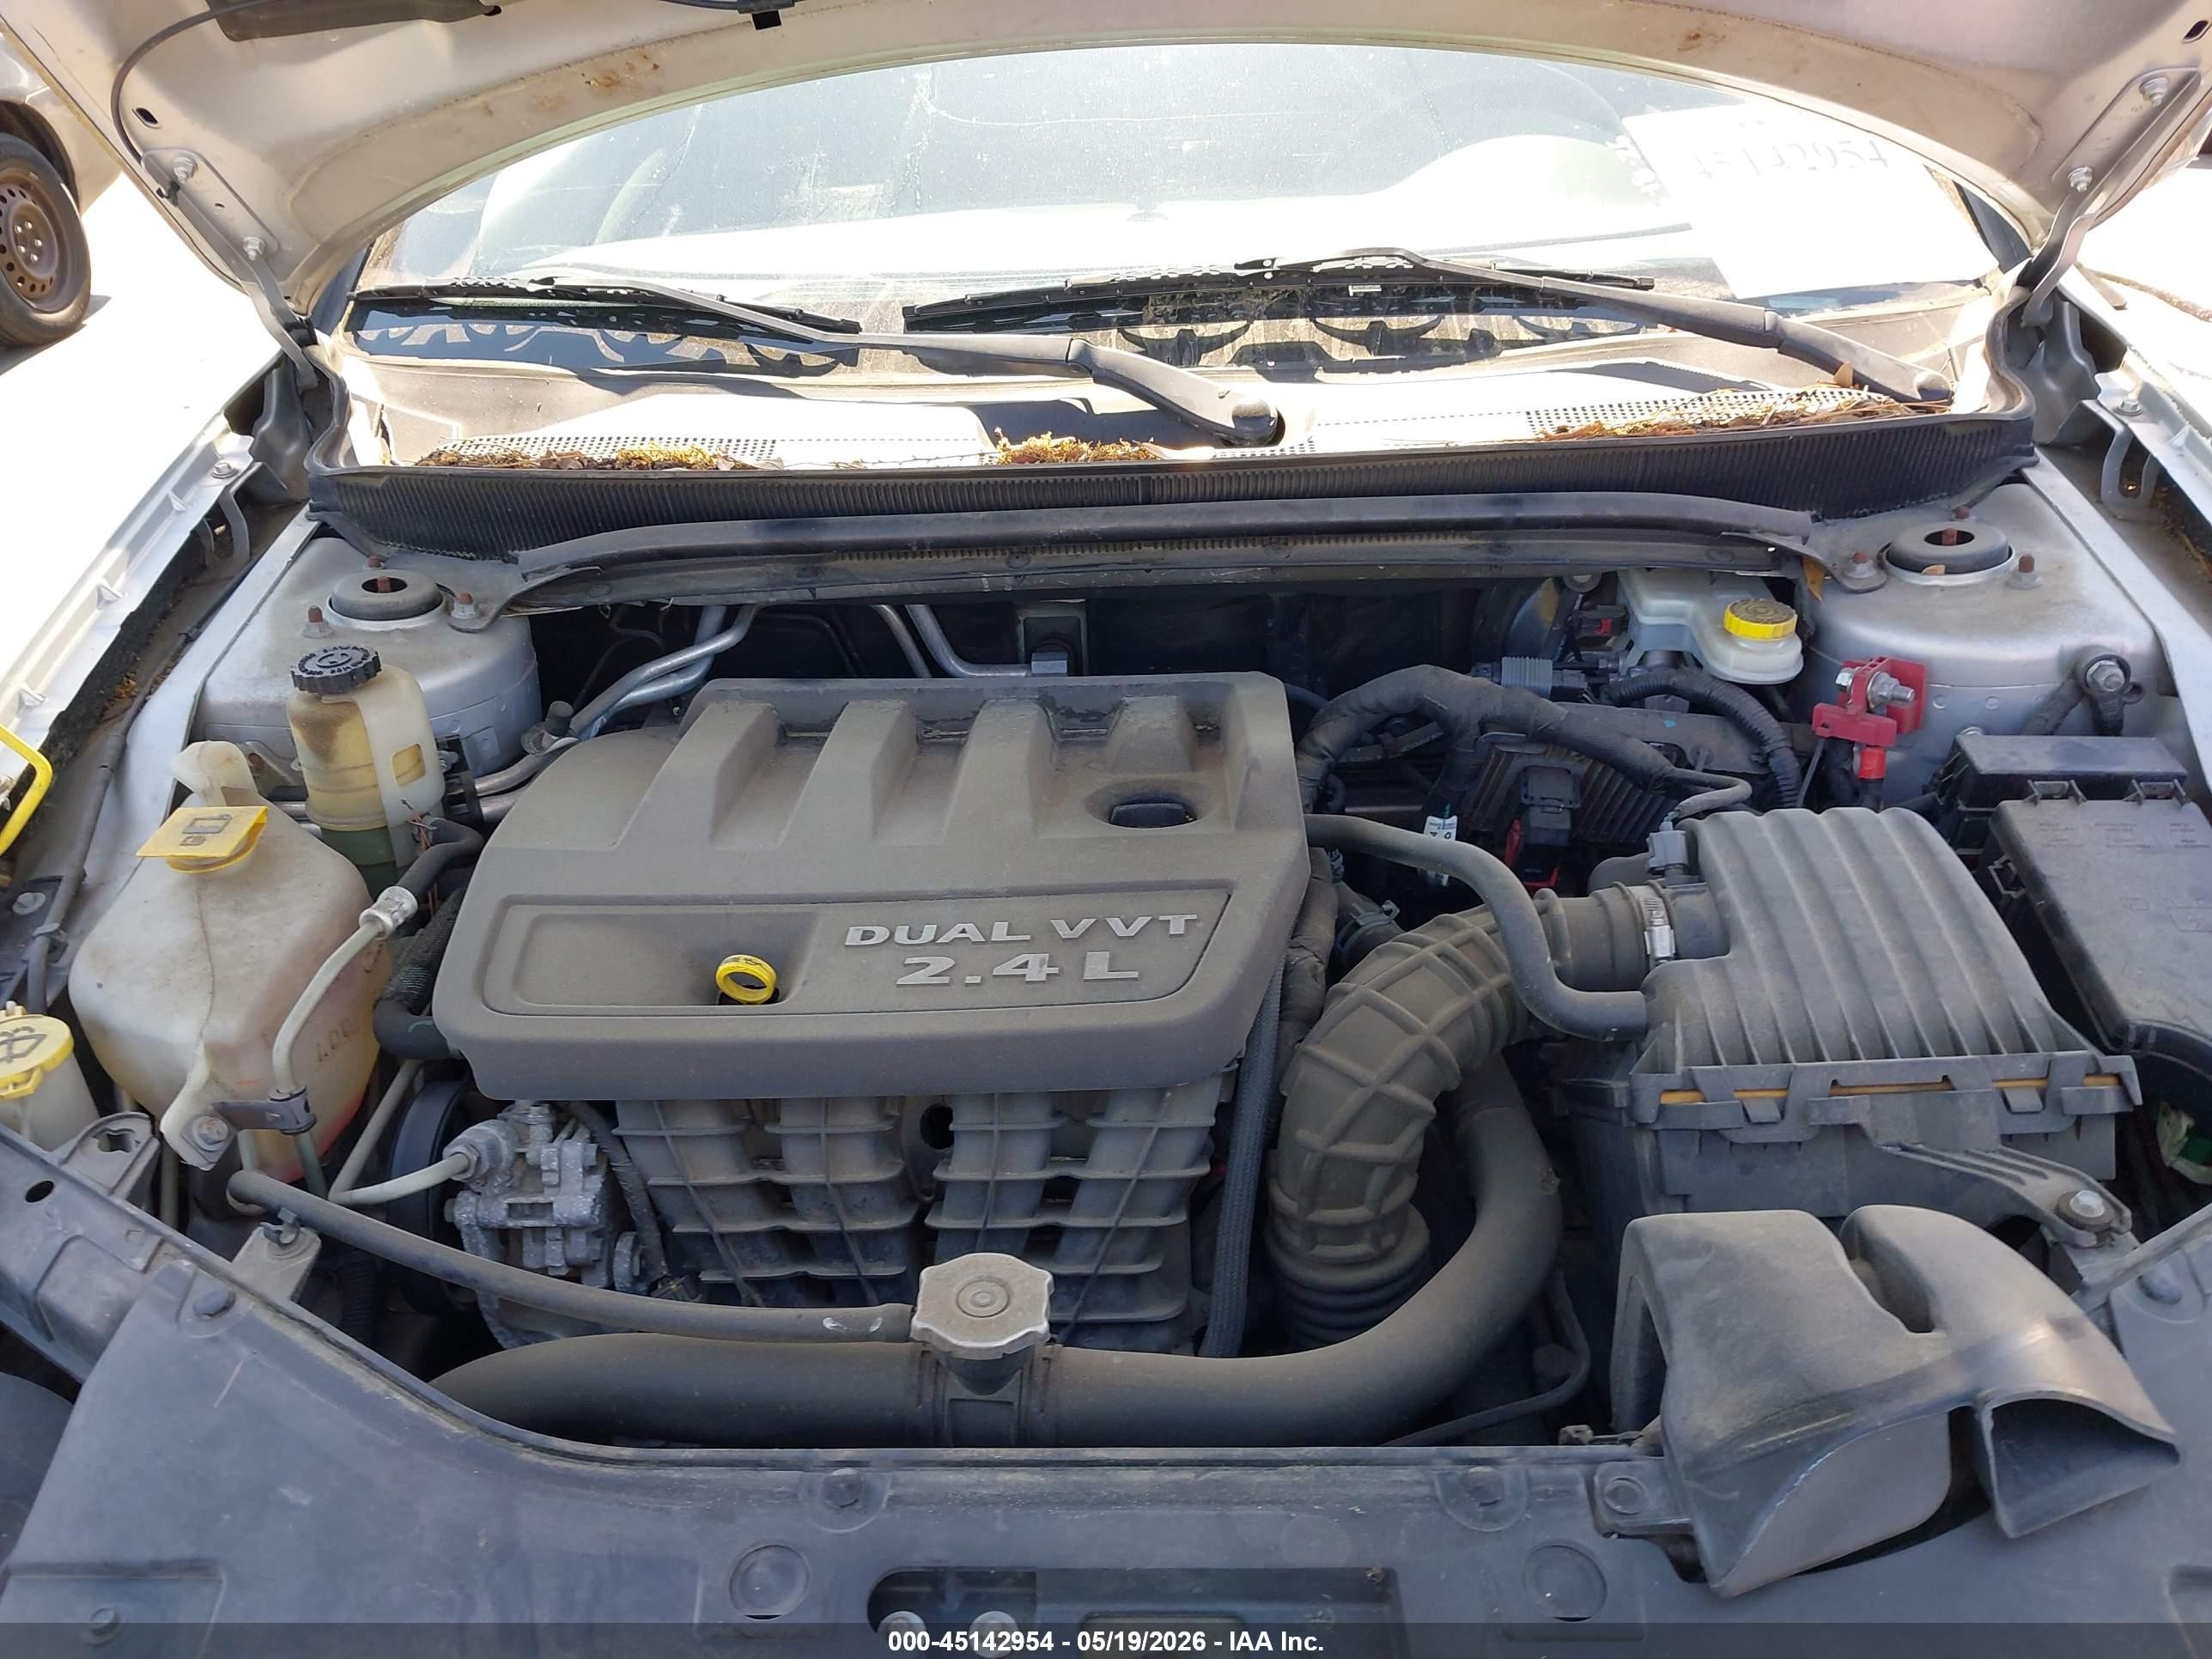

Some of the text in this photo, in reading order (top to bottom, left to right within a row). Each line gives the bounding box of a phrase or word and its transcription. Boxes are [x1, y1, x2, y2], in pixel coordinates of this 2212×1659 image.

[845, 914, 1198, 946] DUAL VVT
[895, 950, 1139, 986] 2.4 L
